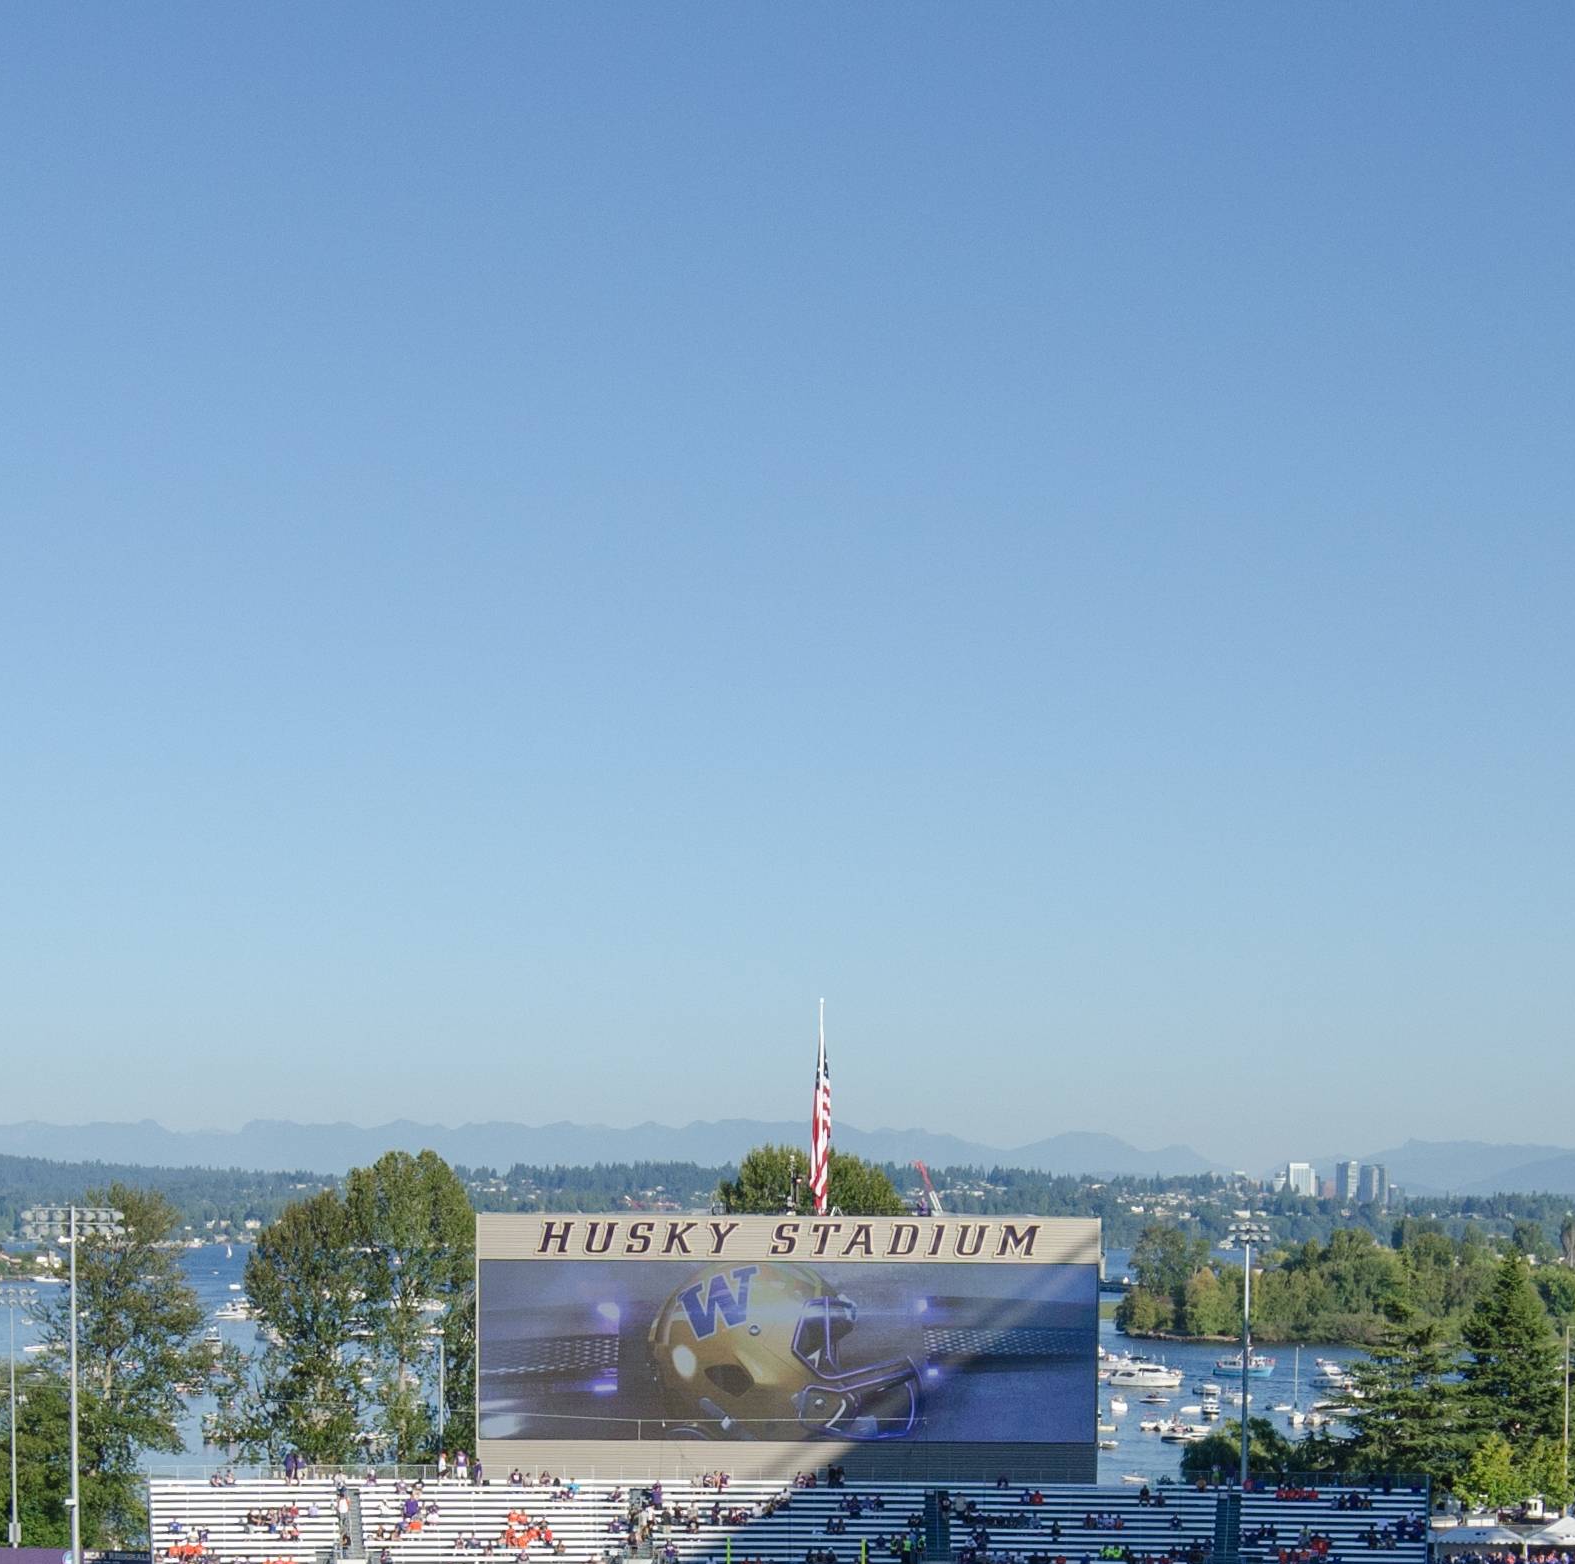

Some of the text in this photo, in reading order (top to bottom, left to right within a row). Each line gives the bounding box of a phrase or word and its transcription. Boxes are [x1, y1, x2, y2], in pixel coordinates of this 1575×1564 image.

[536, 1220, 1041, 1257] HUSKY STADIUM
[676, 1265, 759, 1339] W
